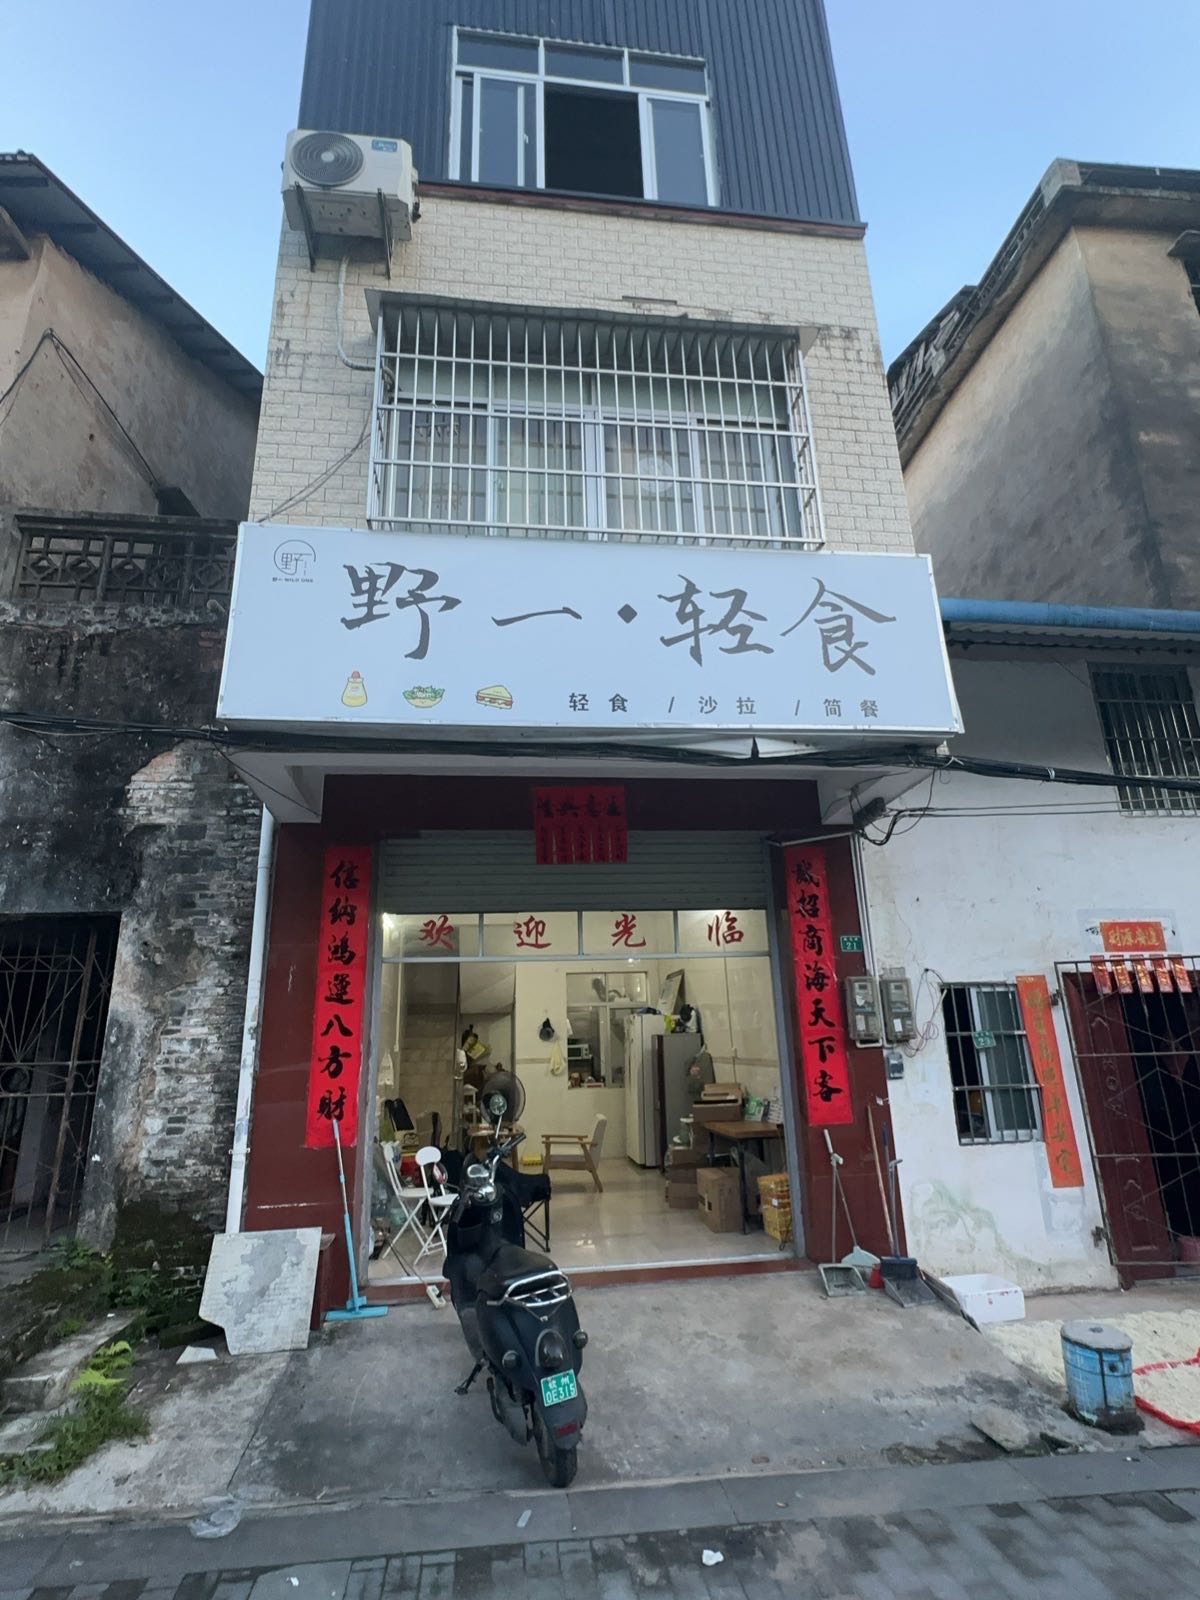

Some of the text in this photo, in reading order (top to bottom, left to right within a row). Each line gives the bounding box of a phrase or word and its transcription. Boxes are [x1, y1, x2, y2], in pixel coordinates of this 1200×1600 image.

[418, 911, 745, 951] 欢迎光临
[846, 942, 857, 950] 21
